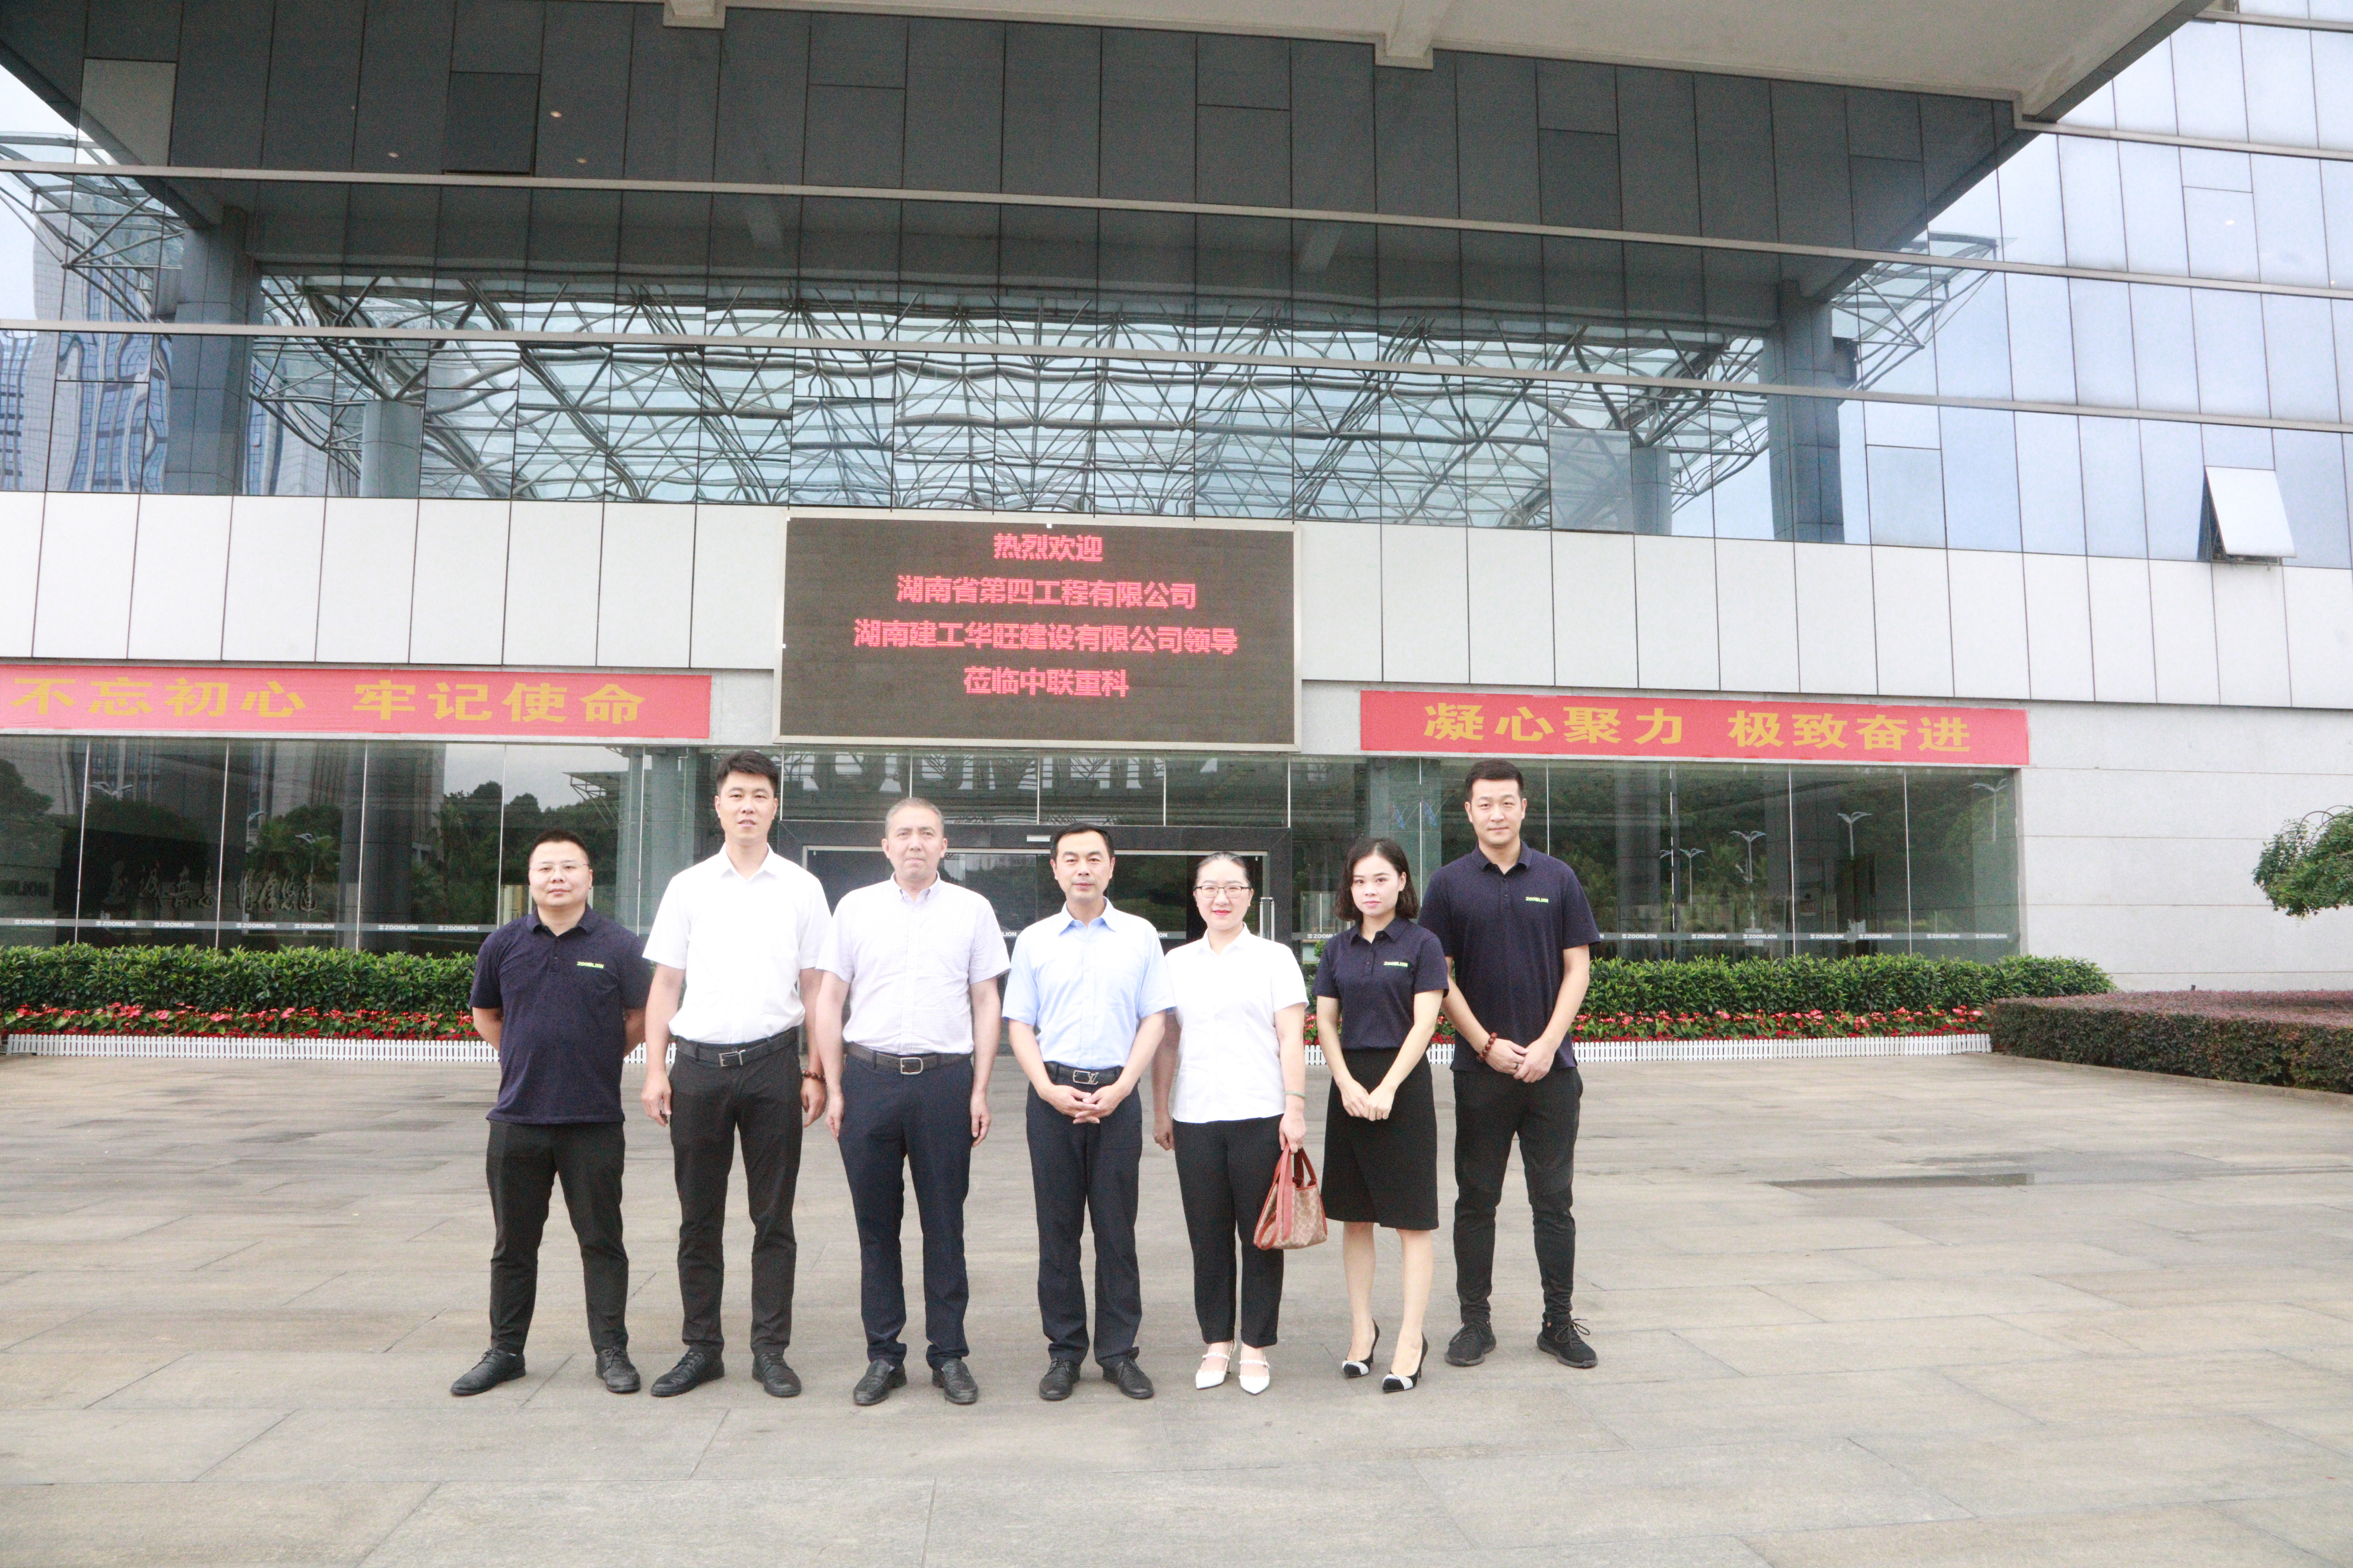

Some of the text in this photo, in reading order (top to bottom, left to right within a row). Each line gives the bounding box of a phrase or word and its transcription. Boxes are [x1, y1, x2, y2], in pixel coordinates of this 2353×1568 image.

[993, 532, 1104, 563] 热烈欢迎
[896, 574, 1197, 610] 湖南省第四工程有限公司
[853, 618, 1239, 656] 湖南建工华旺建设有限公司领导
[963, 665, 1131, 698] 莅临中联重科
[11, 676, 645, 725] 不忘初心 牢记使命
[1424, 702, 1970, 752] 凝心聚力 极致奋进
